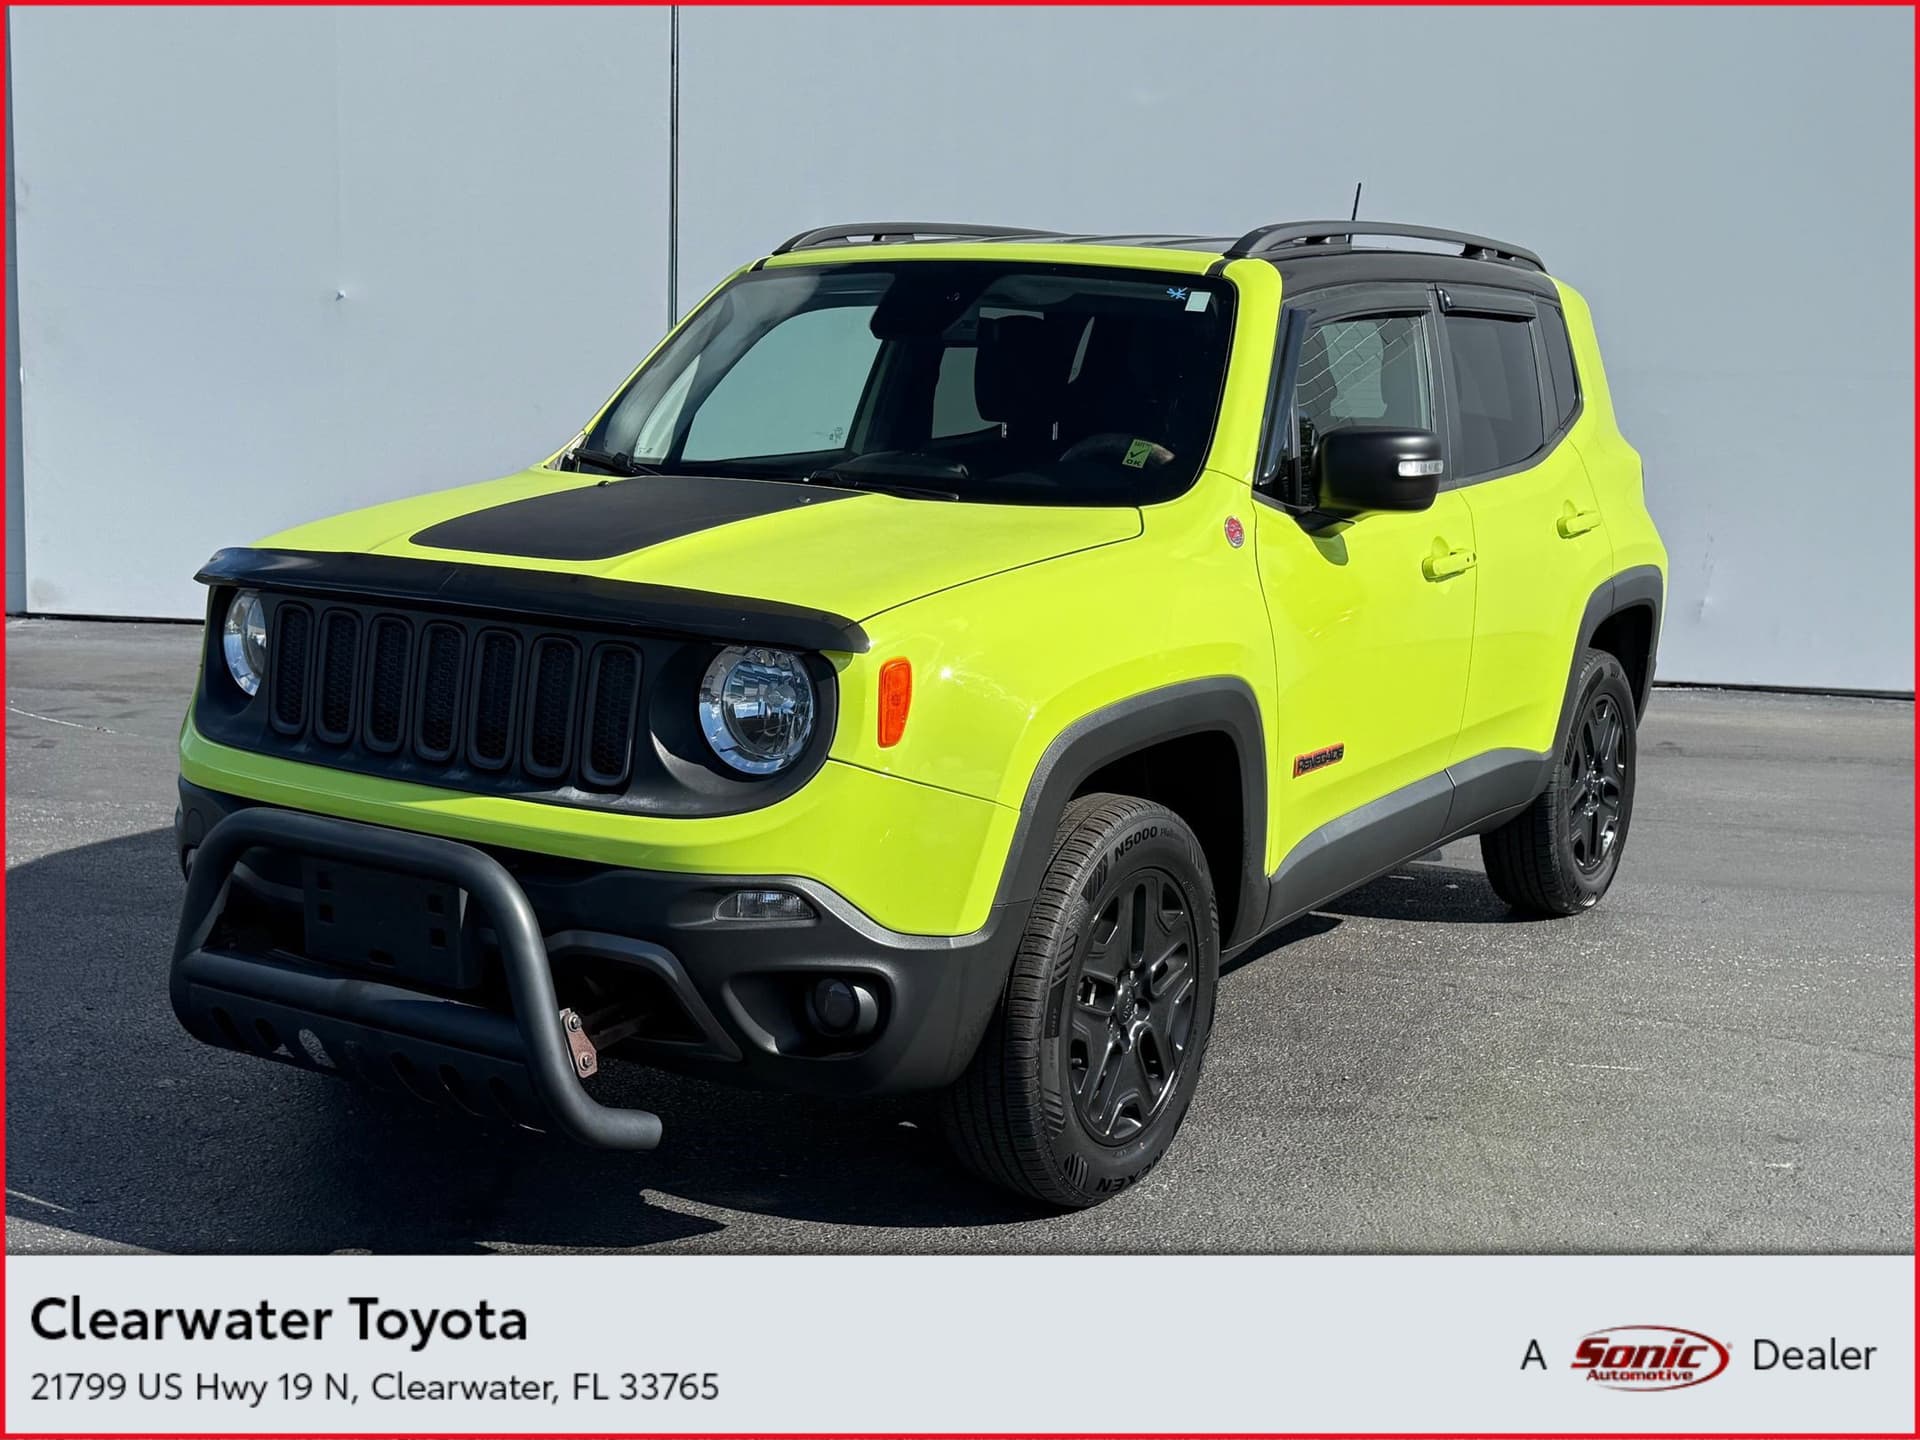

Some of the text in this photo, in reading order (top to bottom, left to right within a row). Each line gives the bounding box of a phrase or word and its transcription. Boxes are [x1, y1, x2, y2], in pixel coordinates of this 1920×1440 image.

[1126, 458, 1143, 467] OK
[1297, 746, 1344, 773] RENEGADE
[1114, 825, 1158, 862] N5000
